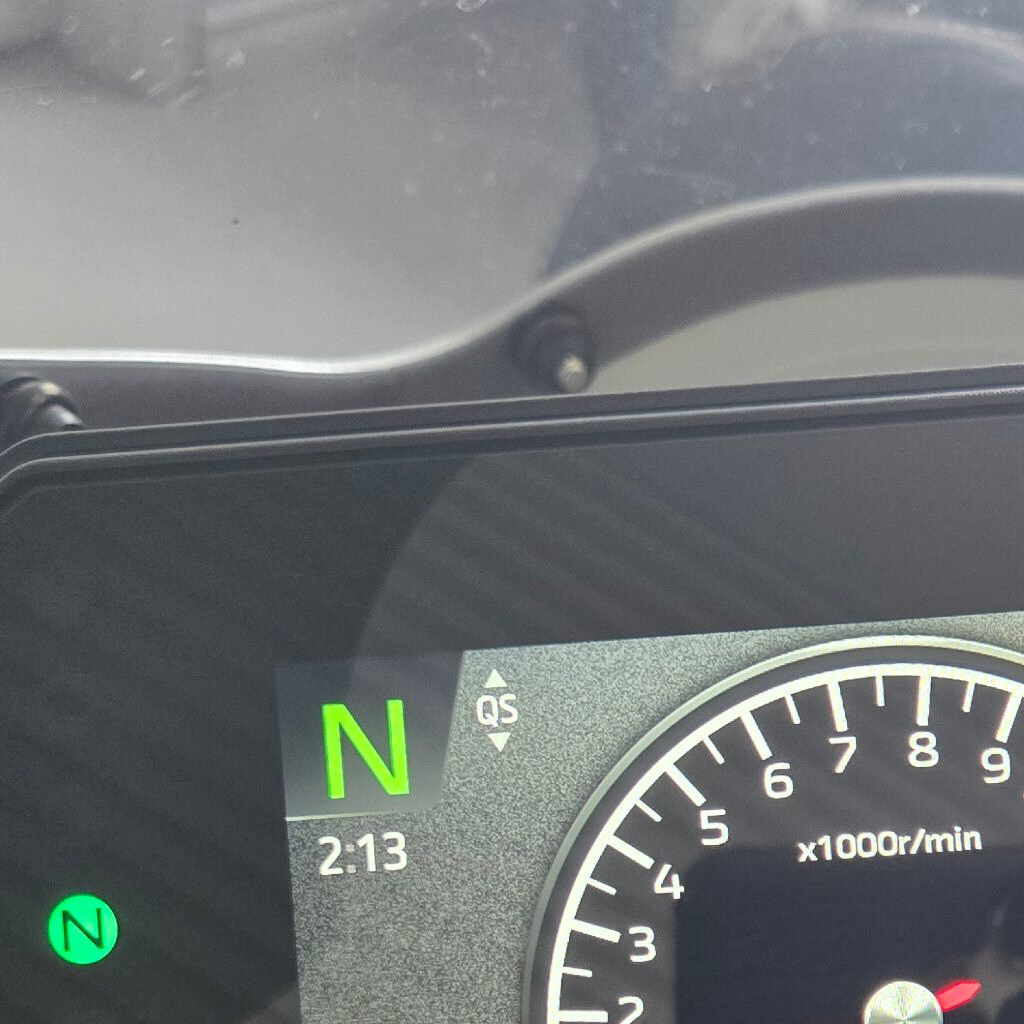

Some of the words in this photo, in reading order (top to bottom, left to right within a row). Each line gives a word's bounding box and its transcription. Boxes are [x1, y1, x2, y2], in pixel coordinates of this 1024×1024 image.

[476, 693, 519, 728] QS
[321, 699, 410, 800] N
[828, 736, 858, 774] 7
[908, 731, 940, 768] 8
[980, 747, 1011, 784] 9
[763, 762, 794, 799] 6
[700, 809, 730, 846] 5
[797, 826, 983, 863] x1000r/min
[318, 831, 409, 876] 2:13
[653, 864, 686, 900] 4
[61, 908, 105, 952] N
[628, 926, 657, 963] 3
